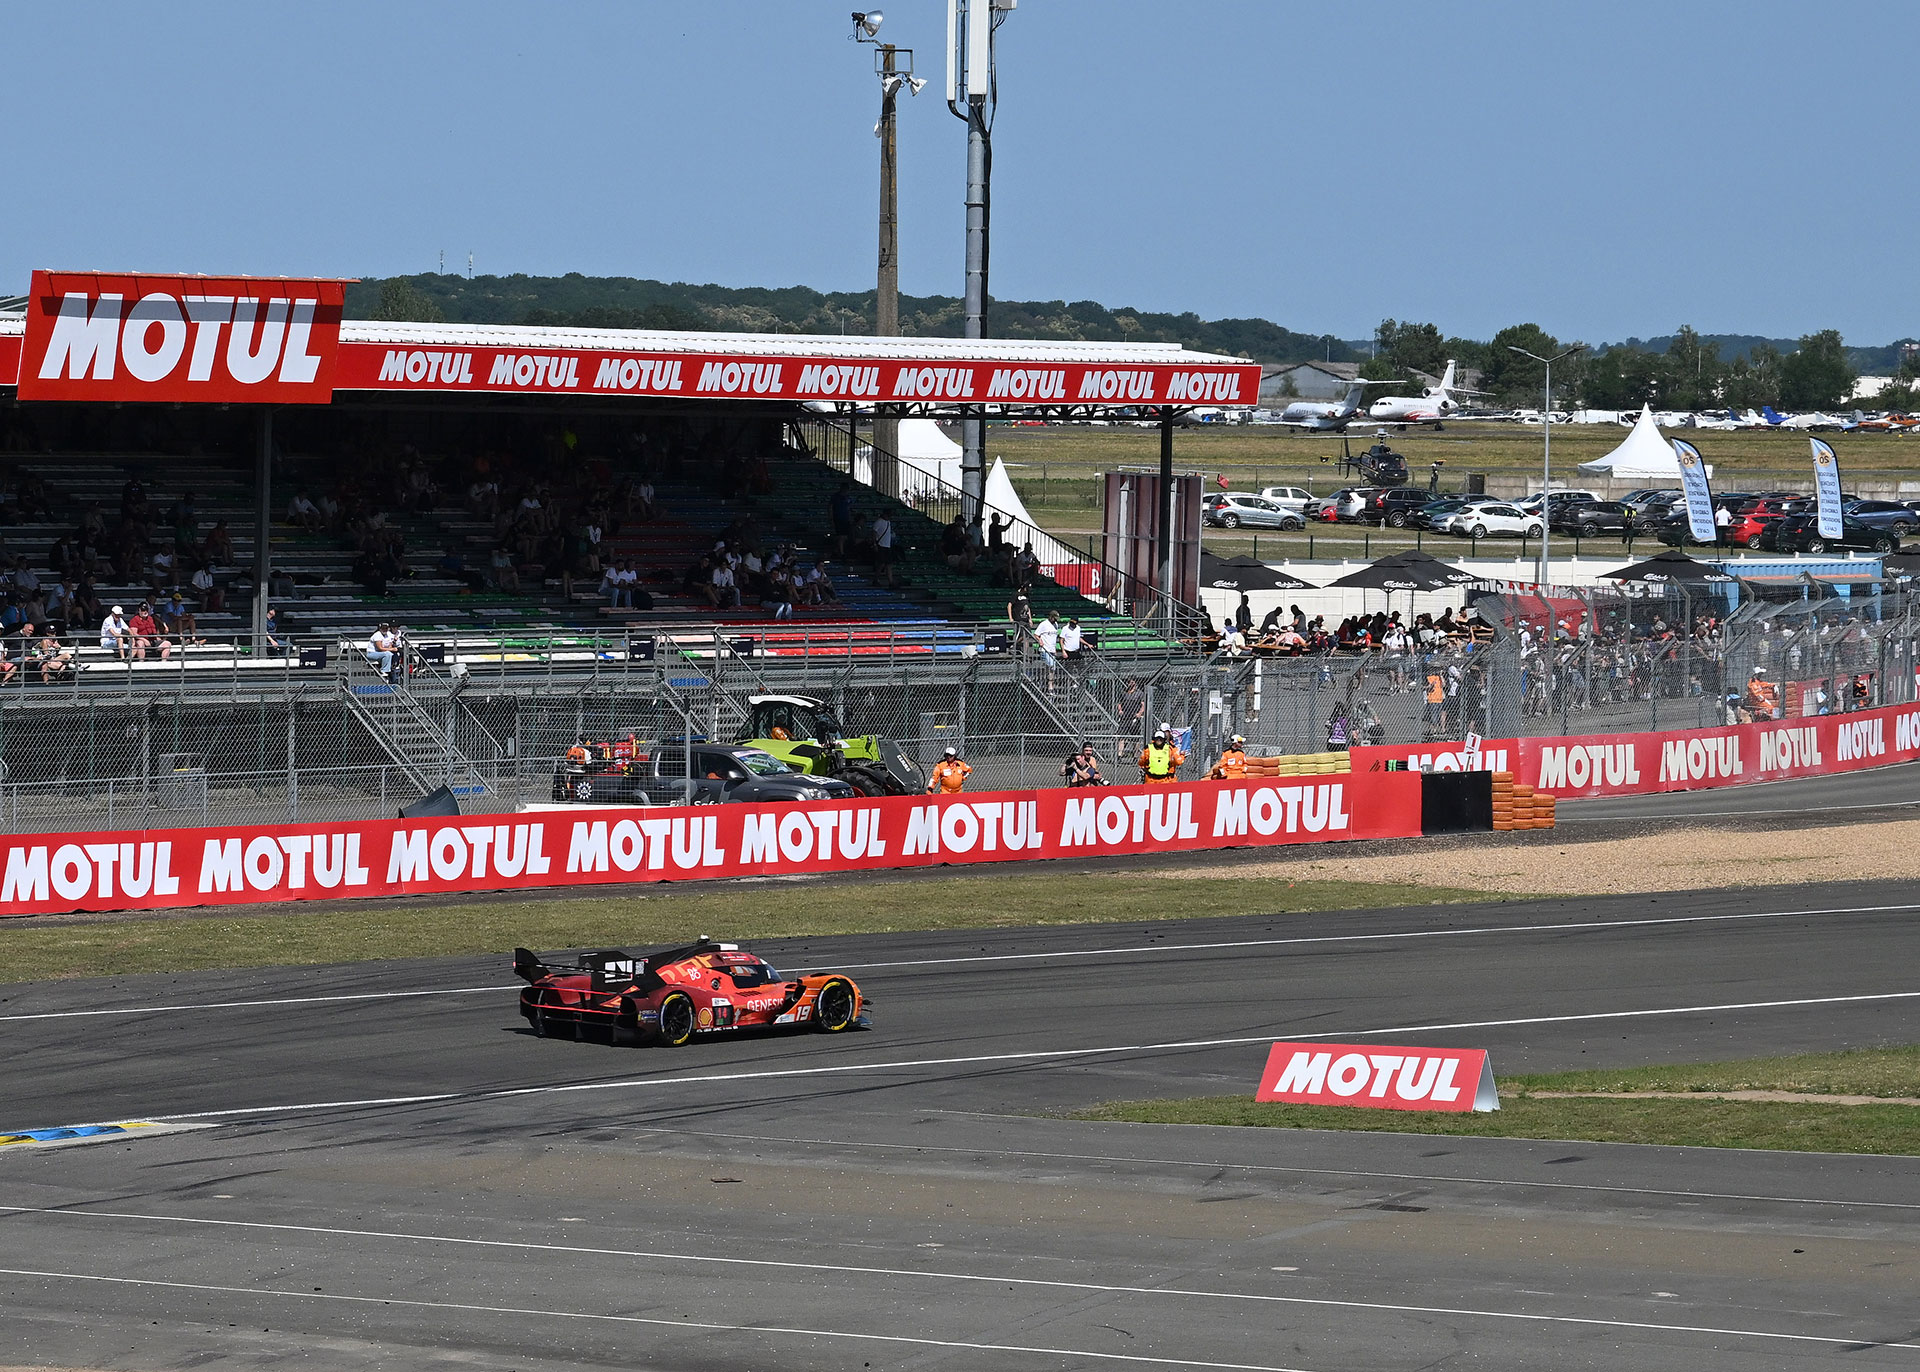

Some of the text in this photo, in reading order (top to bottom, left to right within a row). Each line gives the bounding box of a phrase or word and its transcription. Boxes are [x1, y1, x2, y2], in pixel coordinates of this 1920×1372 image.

[38, 292, 321, 384] MOTUL
[379, 351, 1241, 400] MOTUL MOTUL MOTUL MOTUL MOTUL MOTUL MOTUL MOTUL MOTUL
[1539, 712, 1920, 788] MOTUL MOTUL MOTUL MOTUL MO
[1, 784, 1349, 901] MOTUL MOTUL MOTUL MOTUL MOTUL MOTUL MOTUL MOTUL
[746, 997, 785, 1012] GENESIS
[796, 1005, 811, 1021] 19
[1273, 1052, 1461, 1102] MOTUL
